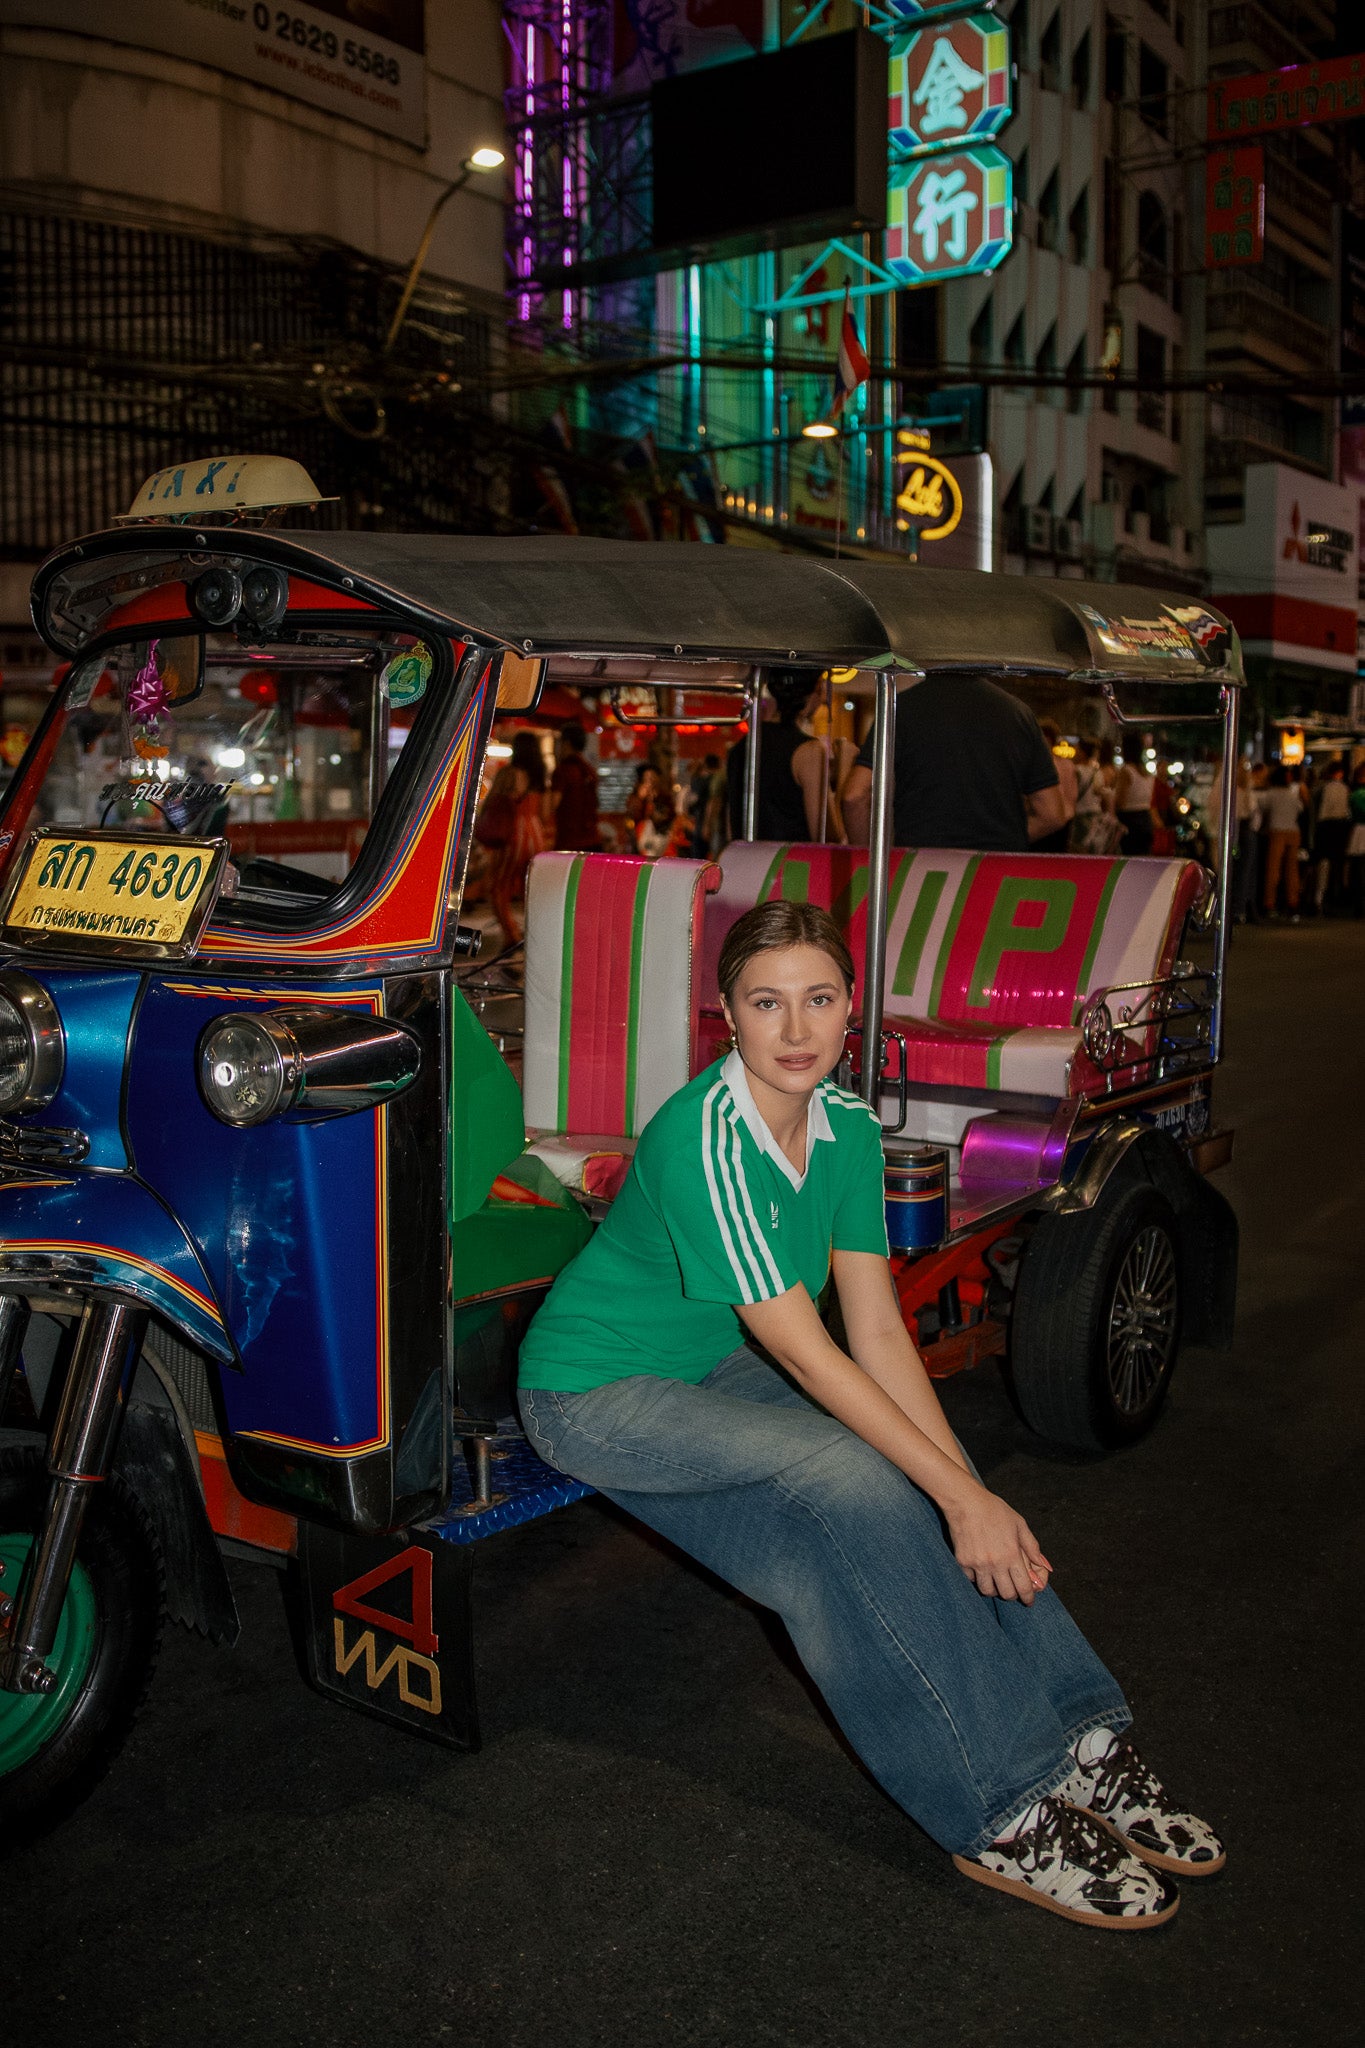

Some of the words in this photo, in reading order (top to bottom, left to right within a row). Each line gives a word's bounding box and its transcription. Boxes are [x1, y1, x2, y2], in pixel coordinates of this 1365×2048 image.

[253, 3, 270, 31] 0
[276, 11, 338, 59] 2629
[343, 39, 400, 86] 5588
[911, 36, 987, 264] 金行
[38, 842, 97, 892] สก
[108, 850, 202, 902] 4630
[332, 1545, 440, 1657] 4
[333, 1617, 443, 1716] WD
